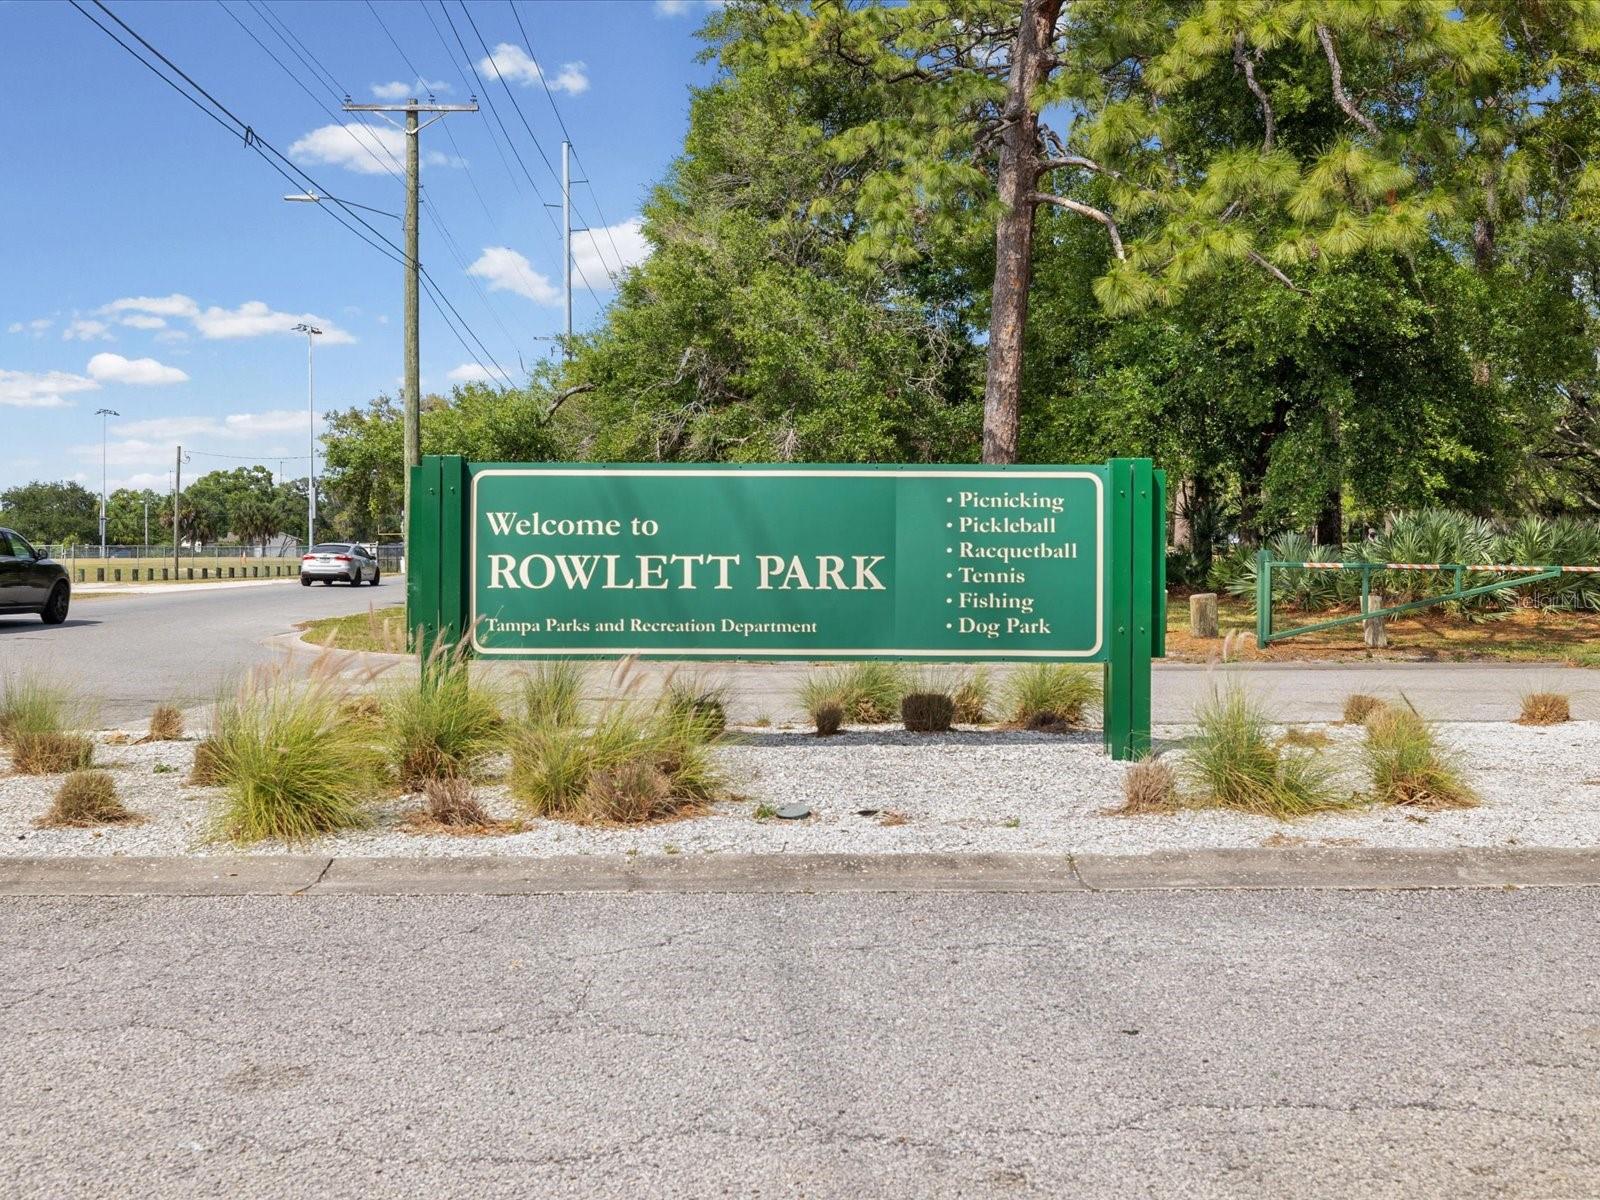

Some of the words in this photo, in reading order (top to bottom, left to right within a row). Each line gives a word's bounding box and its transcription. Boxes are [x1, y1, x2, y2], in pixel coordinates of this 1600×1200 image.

[959, 491, 1065, 513] Picnicking
[485, 511, 621, 537] Welcome
[631, 517, 659, 537] to
[959, 516, 1056, 534] Pickleball
[959, 542, 1077, 563] Racquetball
[486, 553, 741, 590] ROWLETT
[755, 554, 887, 590] PARK
[958, 567, 1026, 584] Tennis
[959, 592, 1035, 614] Fishing
[485, 617, 541, 637] Tampa
[546, 618, 590, 632] Parks
[595, 618, 624, 632] and
[631, 617, 716, 632] Recreation
[721, 618, 817, 637] Department
[958, 617, 1001, 639] Dog
[1006, 617, 1051, 634] Park
